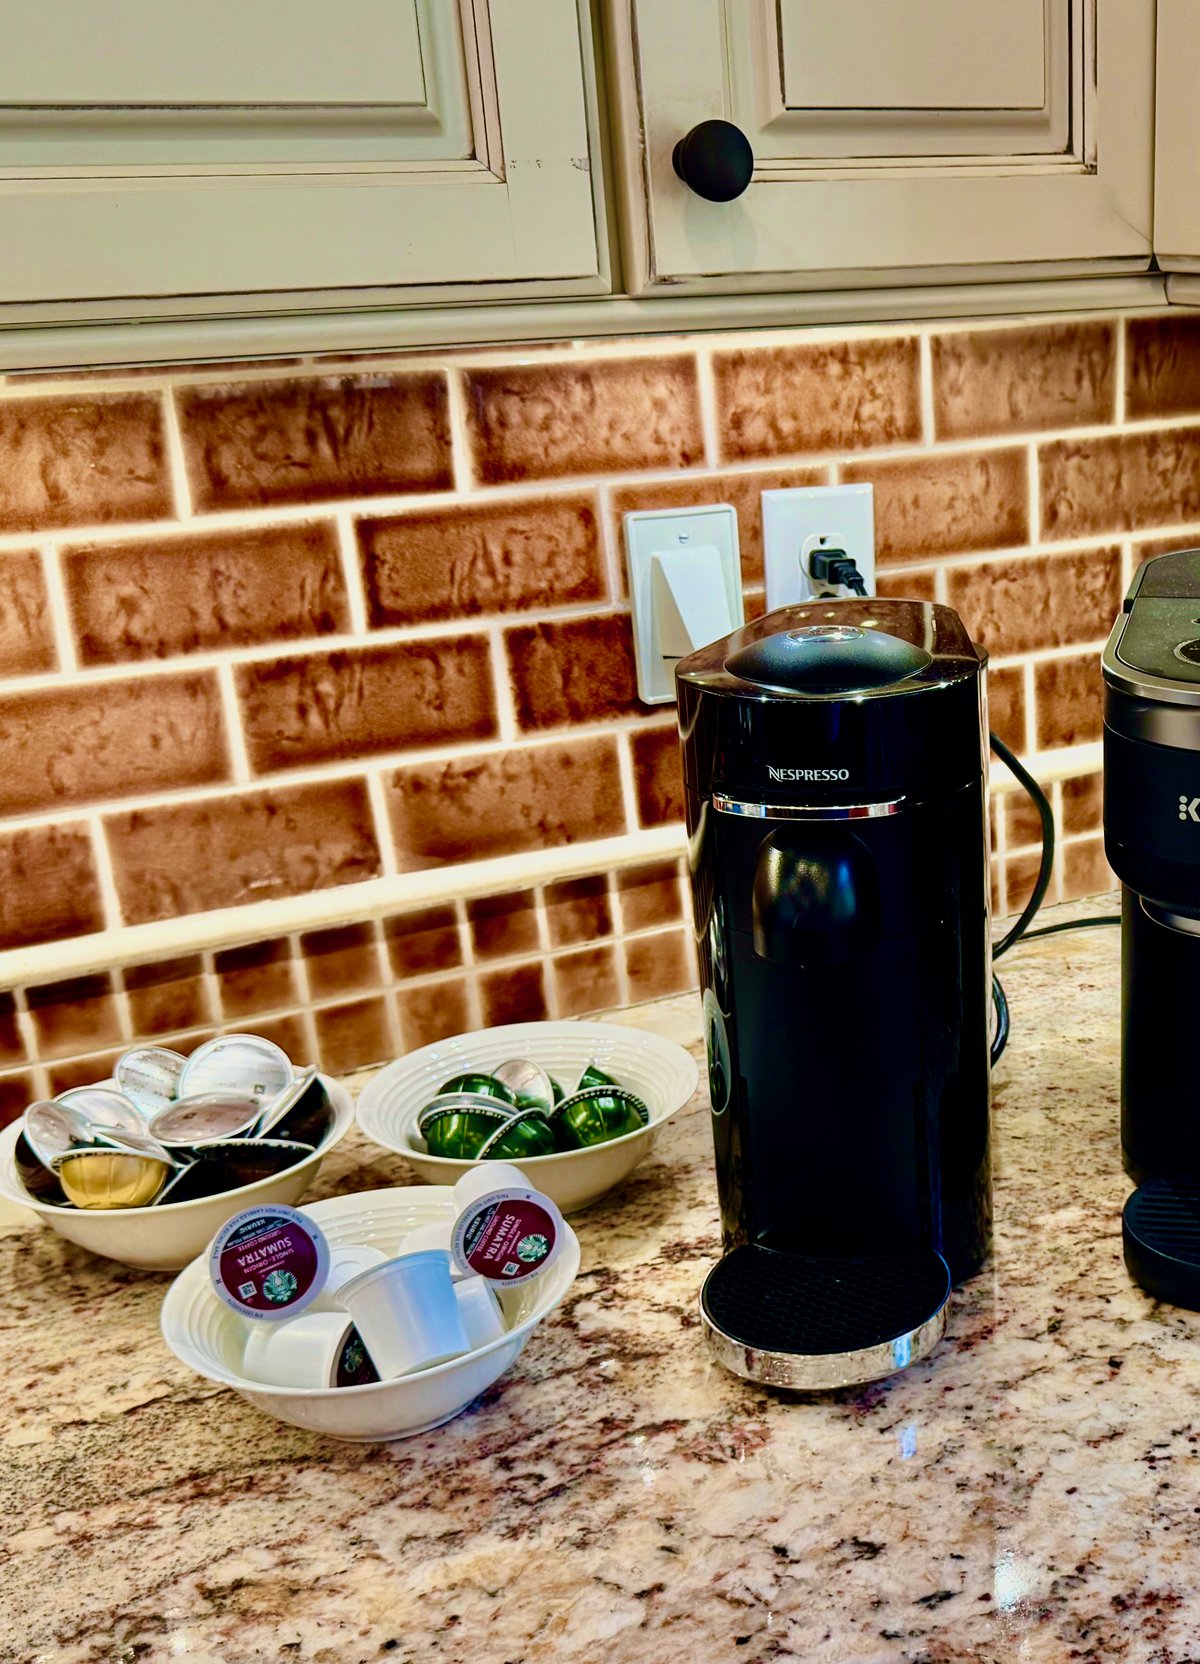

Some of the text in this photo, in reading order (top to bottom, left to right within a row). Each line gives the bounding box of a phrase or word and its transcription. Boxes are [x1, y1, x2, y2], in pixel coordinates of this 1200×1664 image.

[765, 764, 850, 783] NESPRESSO
[236, 1235, 292, 1267] SUMATRA
[482, 1213, 515, 1259] SUMATRA
